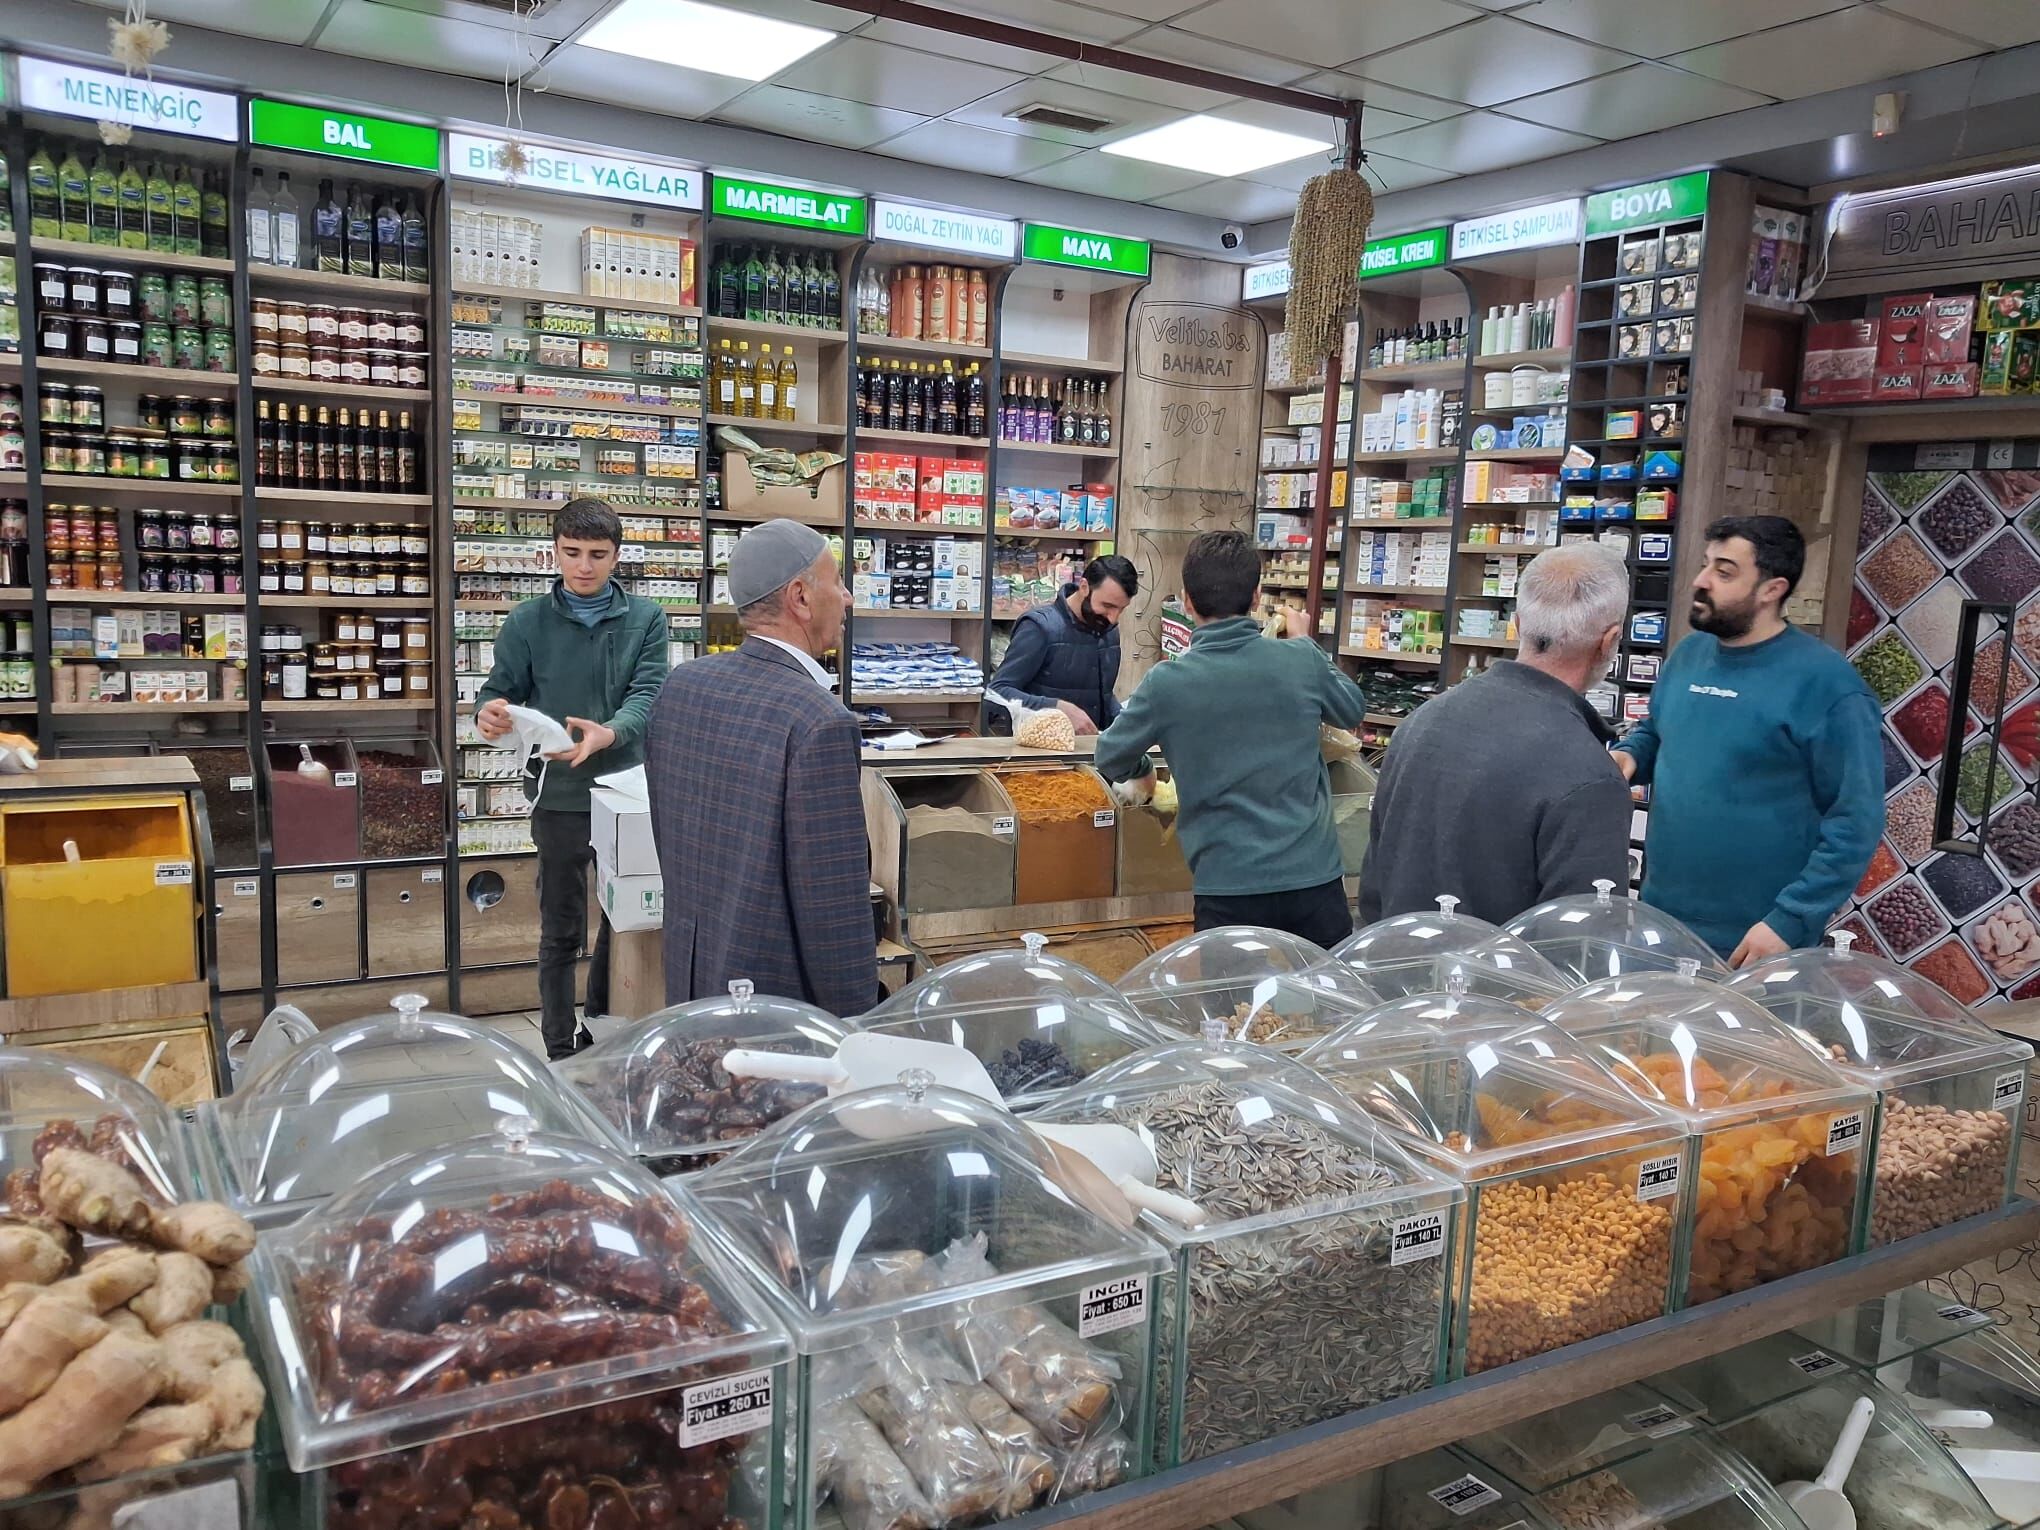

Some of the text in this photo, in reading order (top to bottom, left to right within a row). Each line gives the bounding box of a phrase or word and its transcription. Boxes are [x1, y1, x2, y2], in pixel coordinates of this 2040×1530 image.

[64, 77, 202, 128] MENENGİÇ
[323, 119, 372, 151] BAL
[468, 144, 689, 198] BİİSEL YAĞLAR
[726, 186, 851, 223] MARMELAT
[1611, 188, 1672, 221] BOYA
[886, 210, 1003, 247] DOĞAL ZEYTİN YAĞI
[1458, 211, 1573, 249] BİTKİSEL ŞAMPUAN
[1062, 236, 1113, 262] MAYA
[1401, 240, 1435, 263] KREM
[1890, 305, 1921, 317] ZAZA
[1148, 316, 1250, 353] Velibaba
[1162, 352, 1233, 377] BAHARAT
[1933, 373, 1965, 385] ZAZA
[1881, 376, 1912, 388] ZAZA
[1833, 1114, 1859, 1129] KAYISI
[1642, 1161, 1660, 1172] SOSLU
[1395, 1234, 1413, 1249] Fiyat
[1419, 1230, 1430, 1242] 140
[1432, 1228, 1441, 1239] TL
[1399, 1216, 1439, 1232] DAKOTA
[1083, 1302, 1105, 1320] Fiyat
[1112, 1295, 1129, 1310] 650
[1130, 1291, 1142, 1305] TL
[689, 1375, 770, 1404] CEVİZLİ SUCUK
[687, 1404, 719, 1425] Fiyat
[729, 1395, 751, 1413] 260
[754, 1391, 770, 1406] TL
